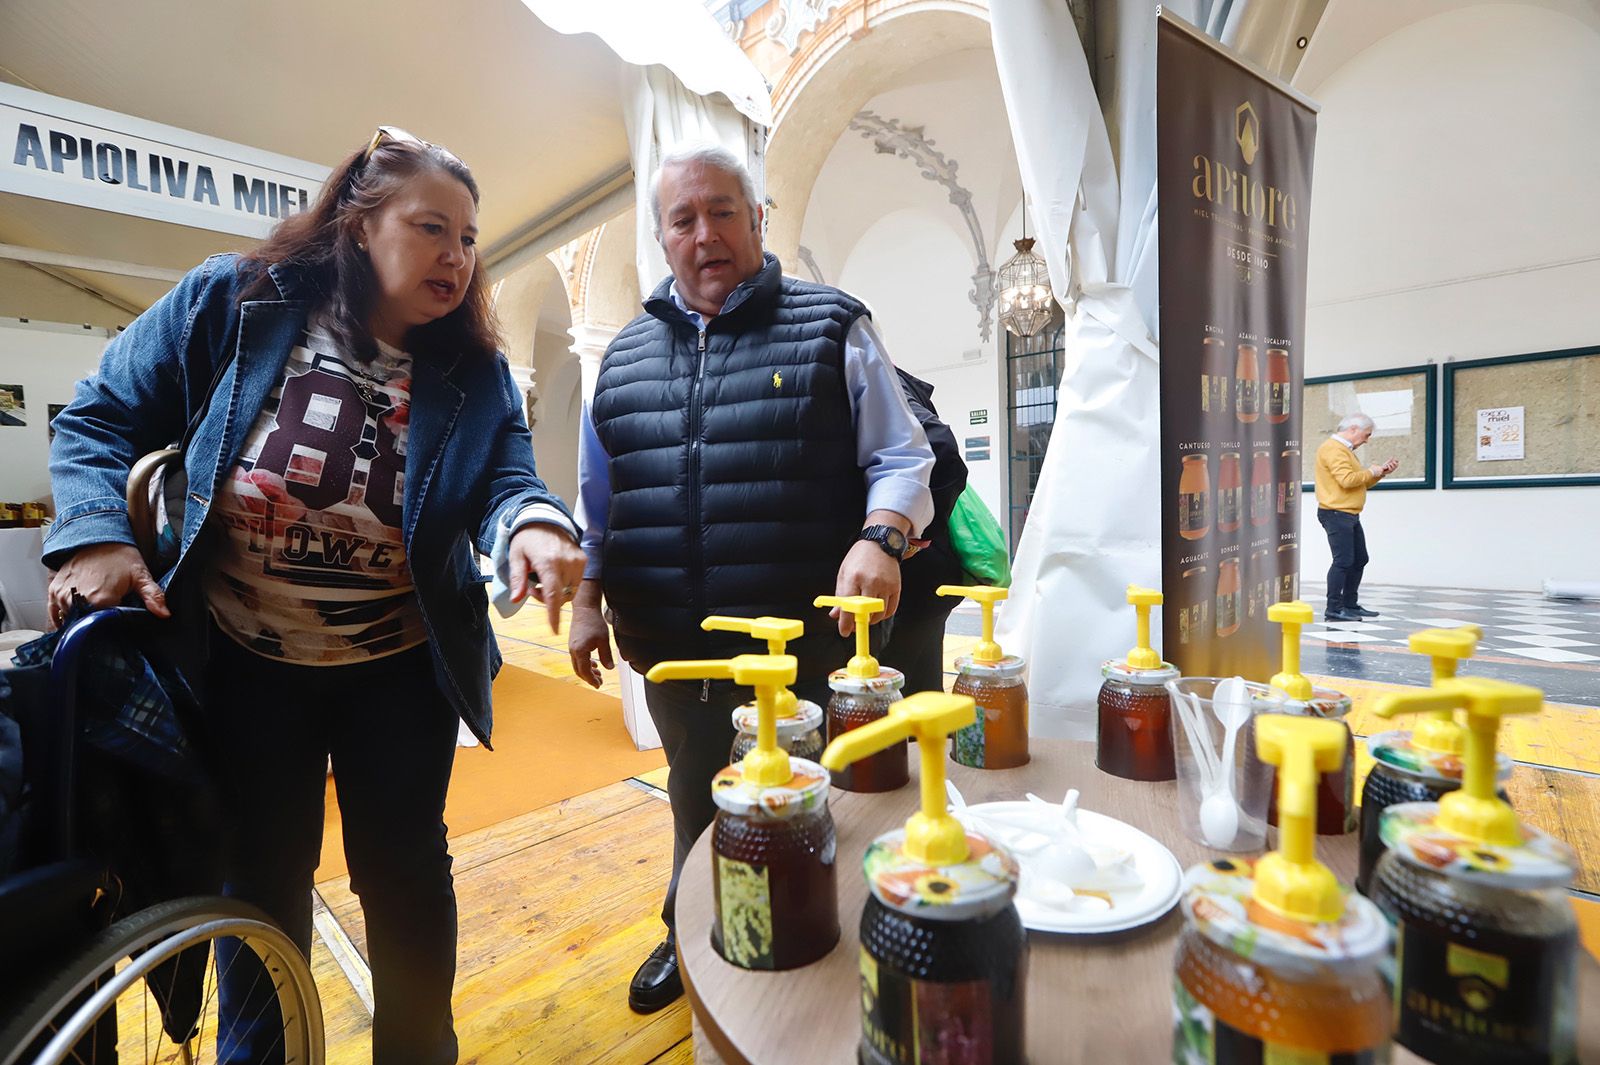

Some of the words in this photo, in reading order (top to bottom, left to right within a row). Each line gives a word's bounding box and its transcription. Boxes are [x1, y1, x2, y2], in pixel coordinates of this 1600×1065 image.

[13, 123, 220, 206] APIOLIVA
[1227, 246, 1251, 262] DESDE
[1263, 337, 1292, 347] EUCALIPTO
[1488, 414, 1510, 422] miel
[1502, 432, 1520, 442] 22
[1179, 442, 1210, 450] CANTUESO
[1220, 441, 1241, 449] TOMILLO
[1281, 532, 1297, 541] ROBLE
[1180, 552, 1209, 564] AGUACATE
